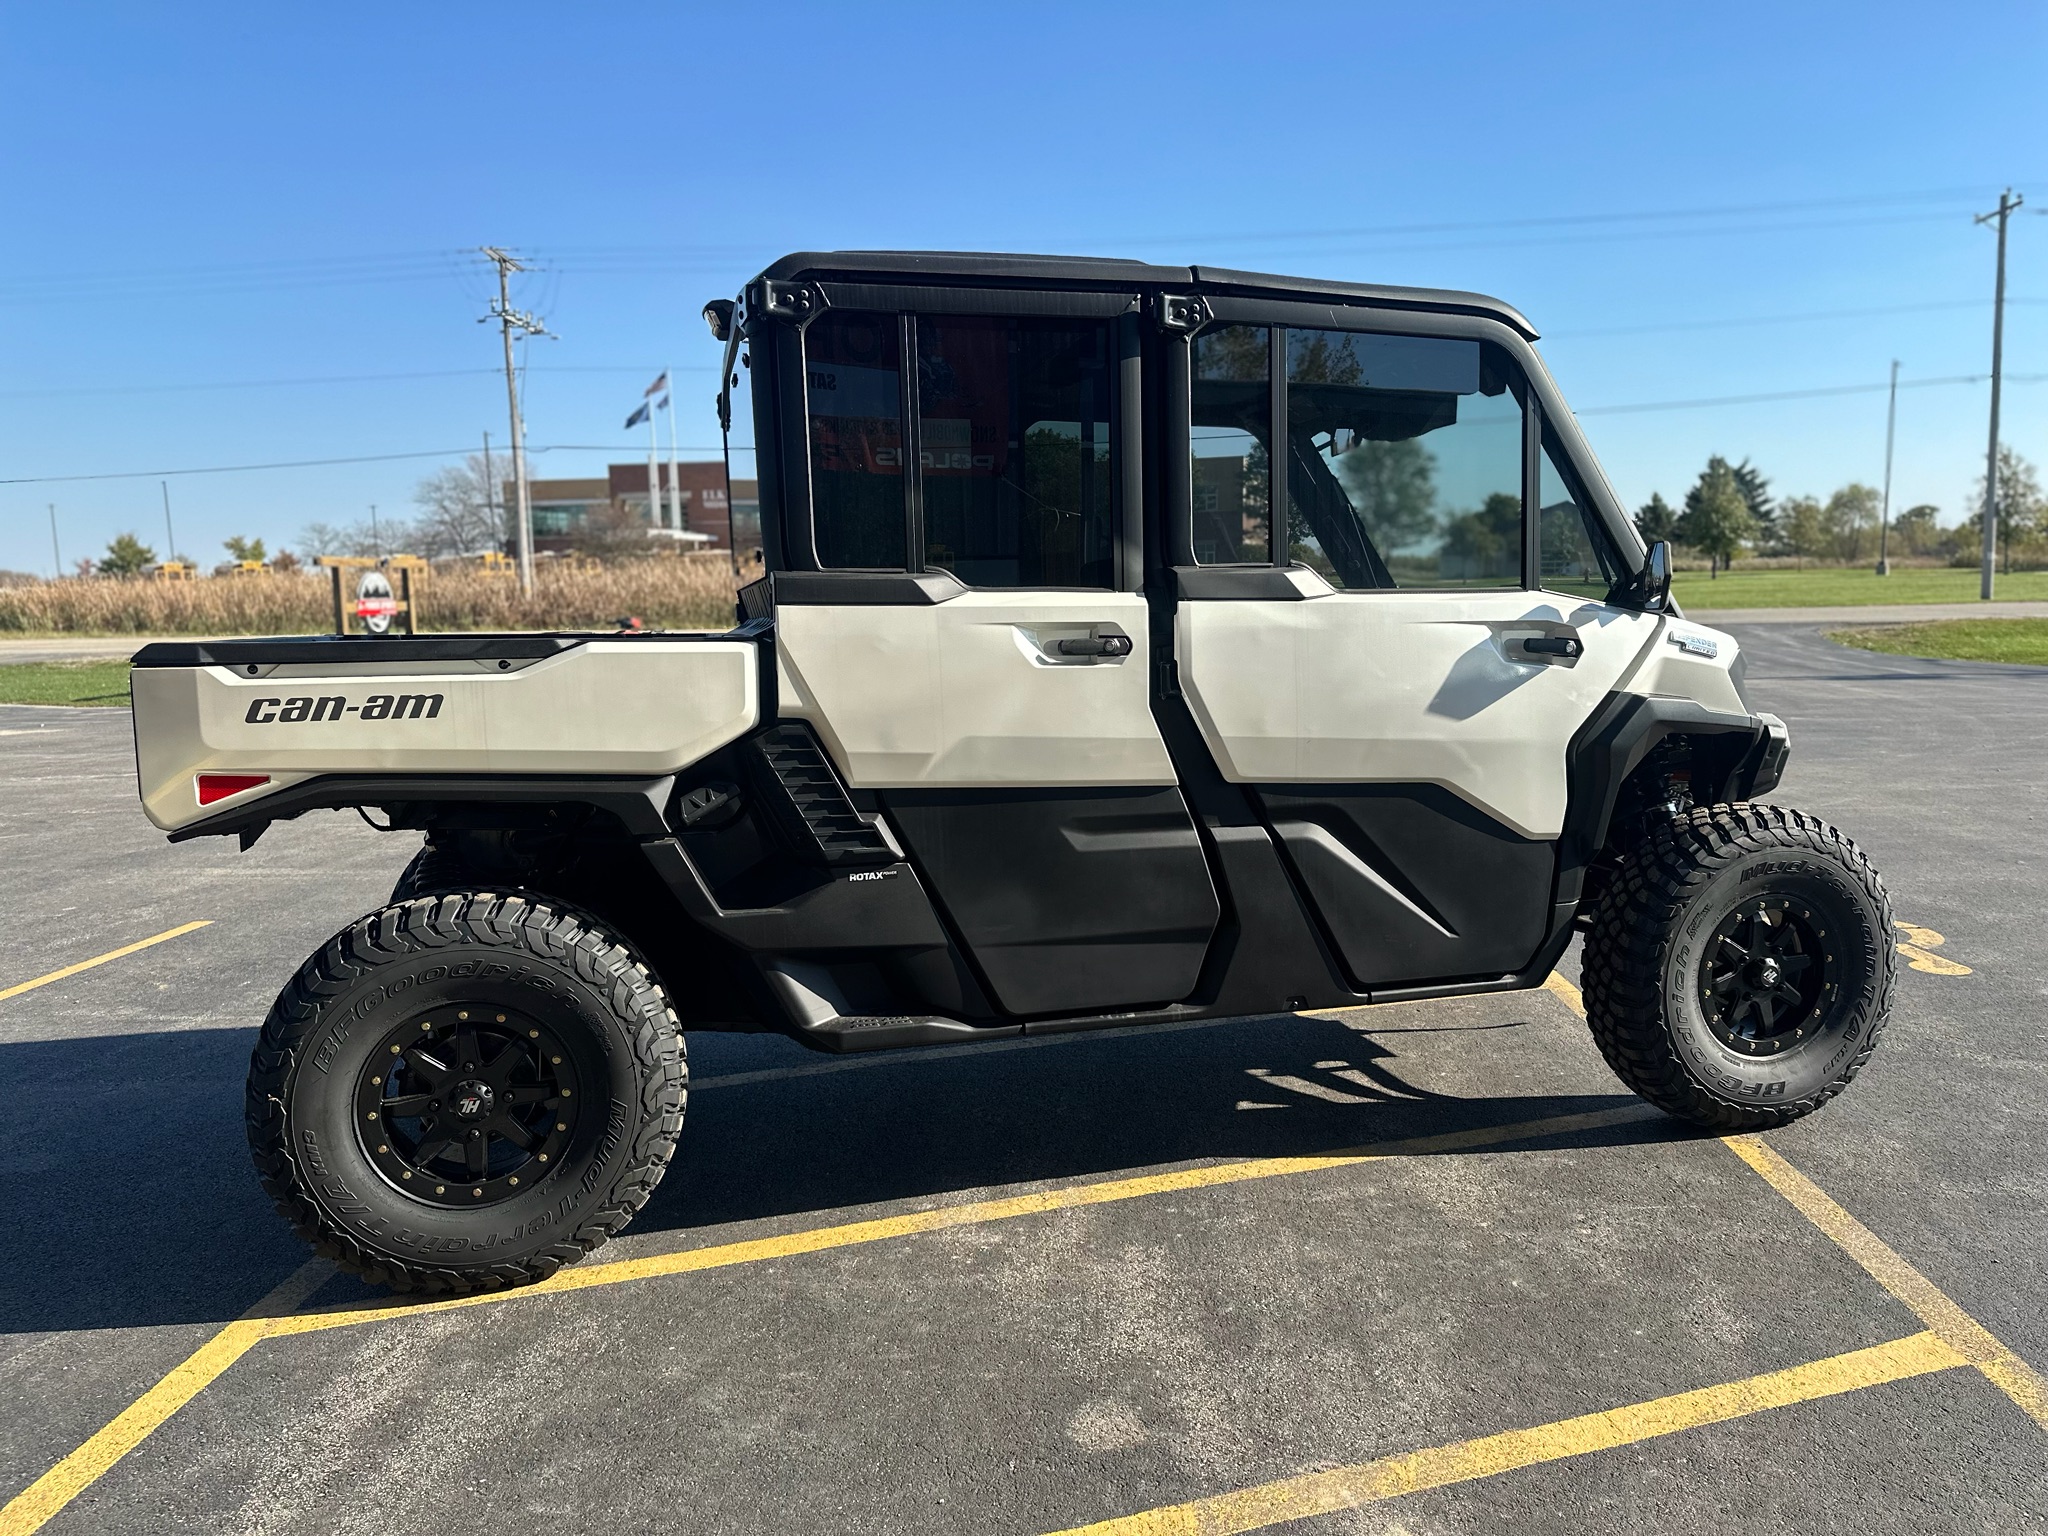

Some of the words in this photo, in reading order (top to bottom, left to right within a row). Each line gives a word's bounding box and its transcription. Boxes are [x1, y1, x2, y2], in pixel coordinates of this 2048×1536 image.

[245, 693, 445, 725] can-am
[849, 871, 884, 882] ROTAX
[313, 958, 581, 1074] BFGoodrich
[1671, 943, 1786, 1097] BFGoodrich
